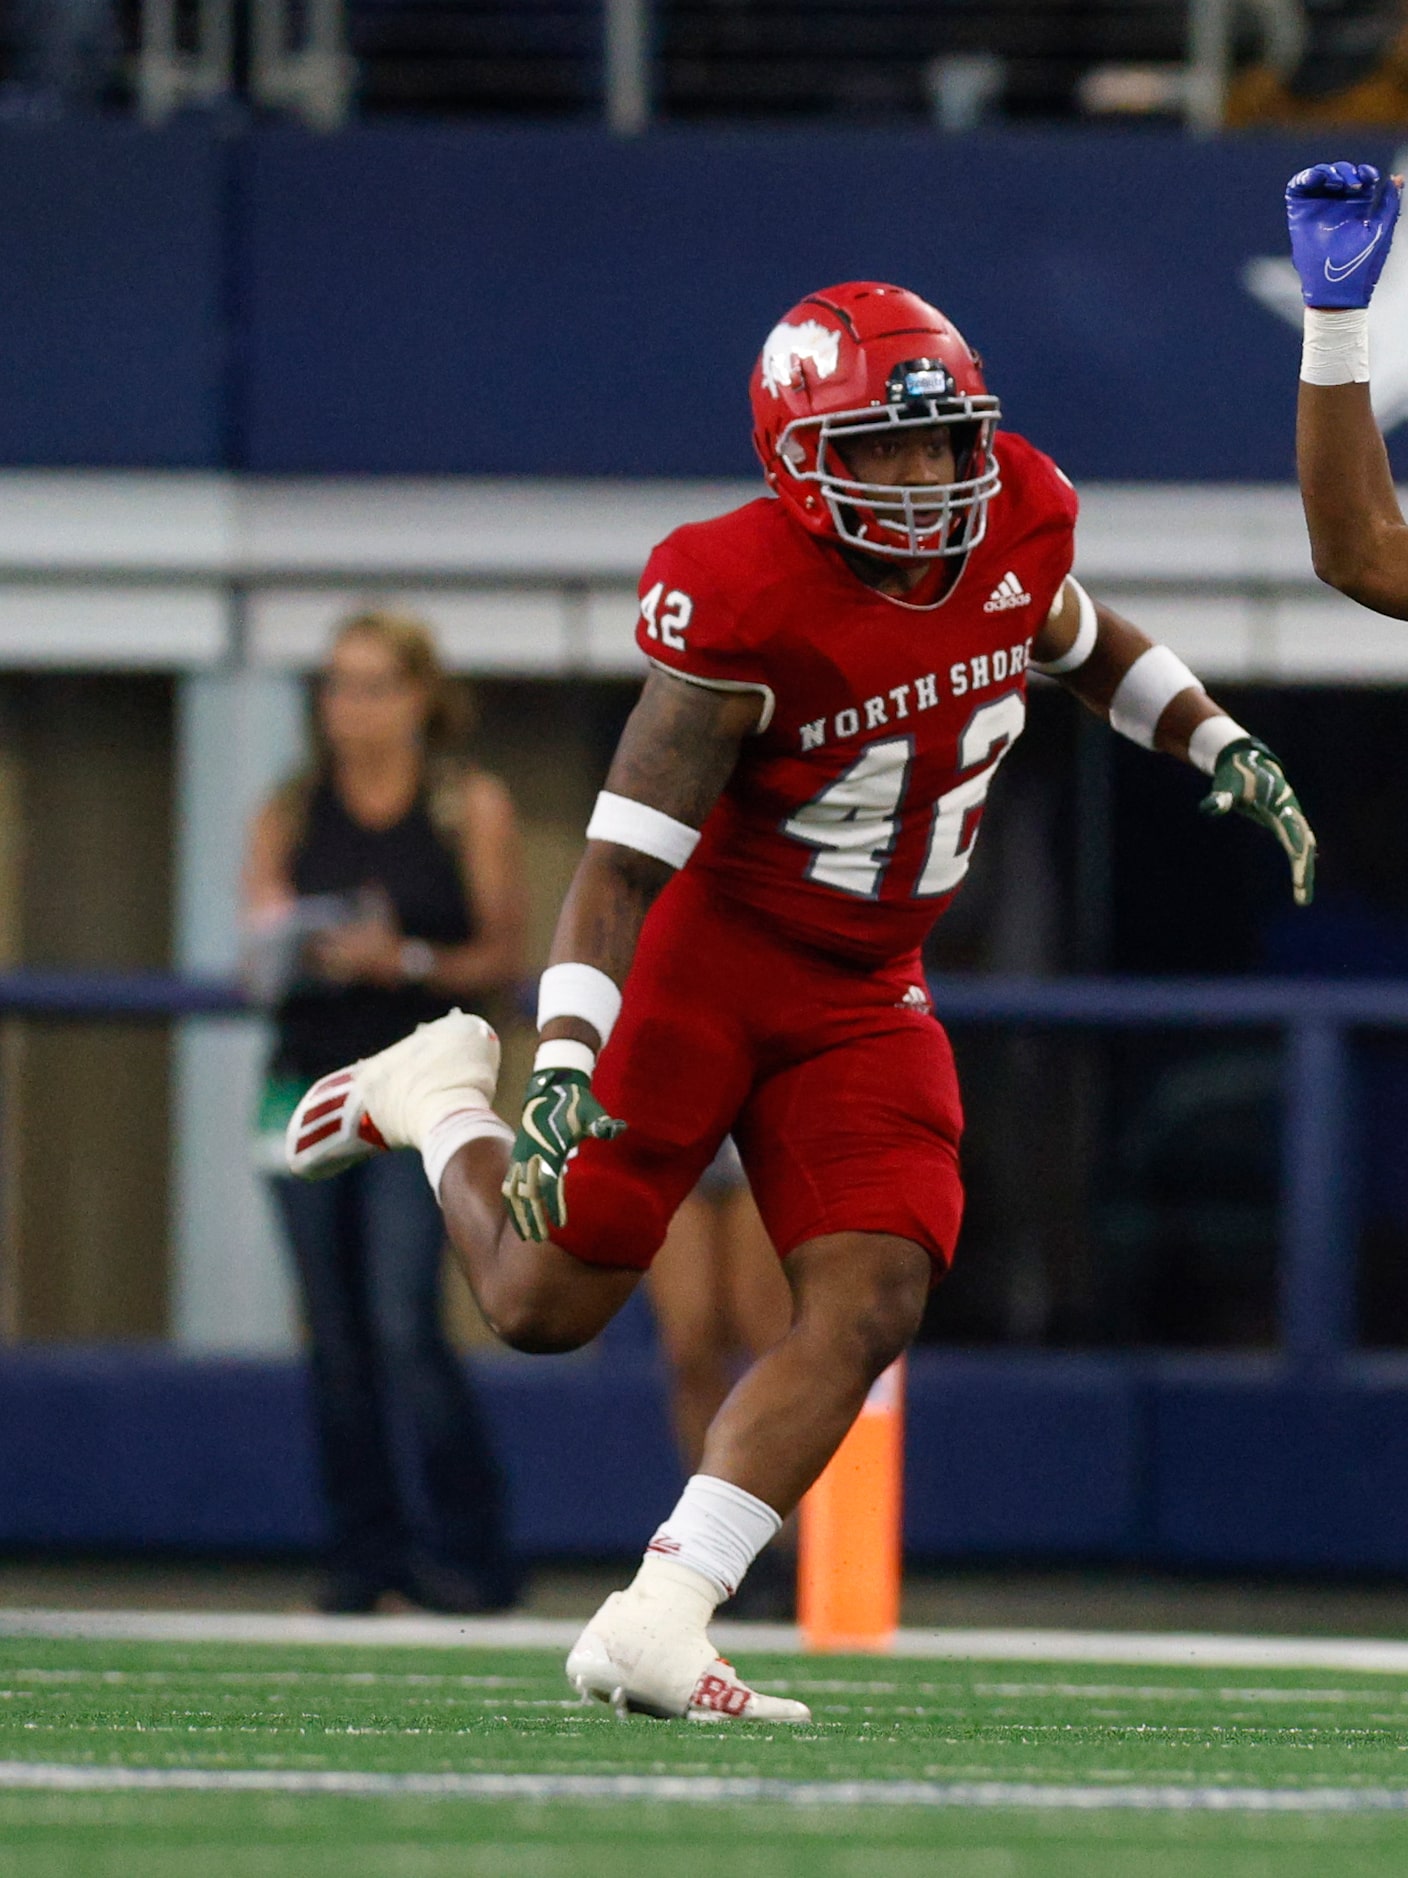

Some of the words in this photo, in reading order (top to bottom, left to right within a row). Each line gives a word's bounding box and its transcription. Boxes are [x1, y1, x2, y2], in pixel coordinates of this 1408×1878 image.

[639, 580, 694, 651] 42
[983, 592, 1031, 613] adidas
[799, 674, 938, 751] NORTH
[779, 690, 1027, 901] 42
